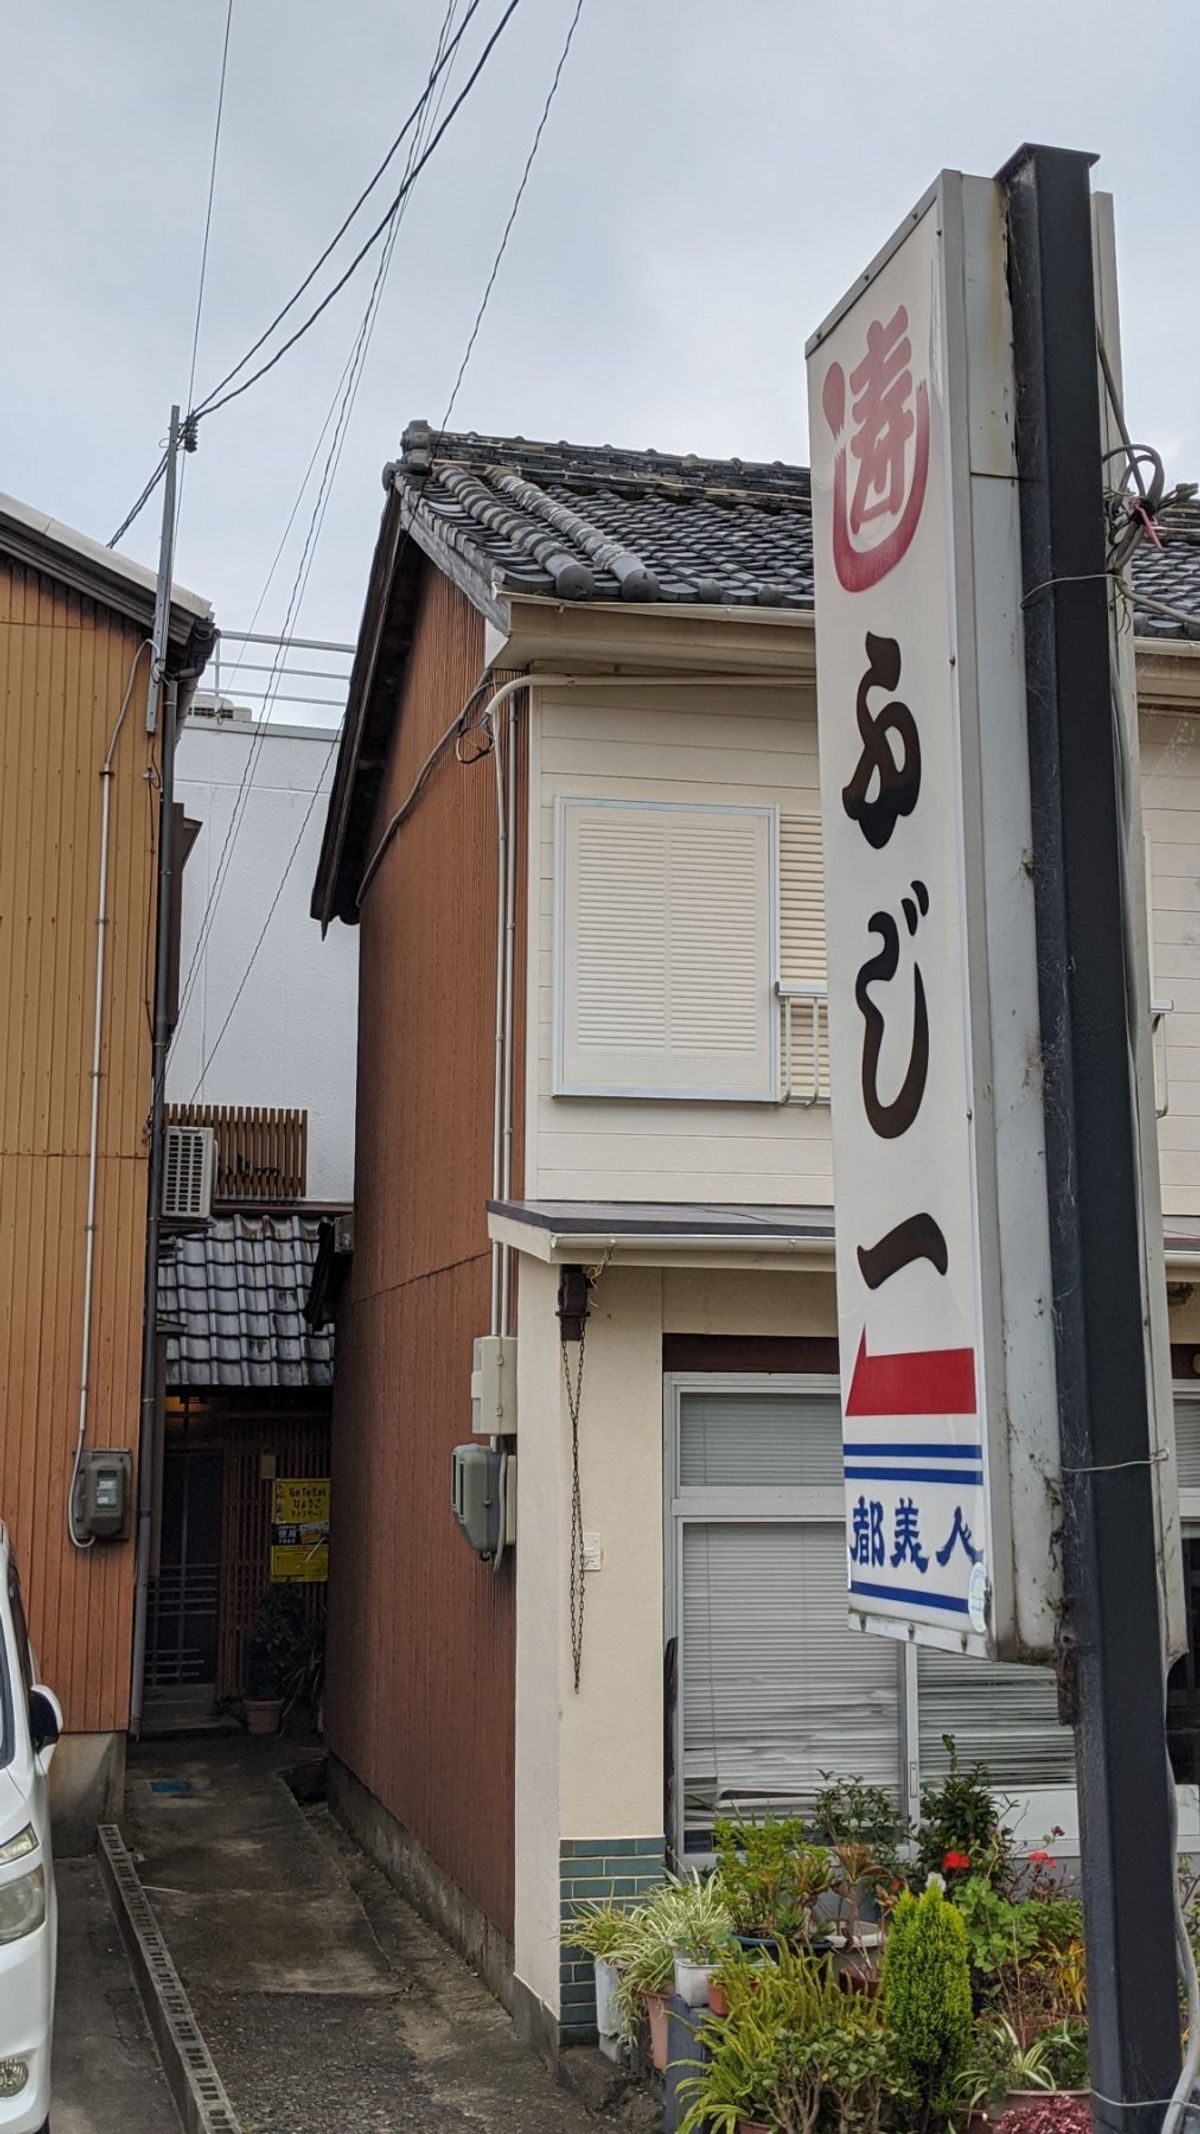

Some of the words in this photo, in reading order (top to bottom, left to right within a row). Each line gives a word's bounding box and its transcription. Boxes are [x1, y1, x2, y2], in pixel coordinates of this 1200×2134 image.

[289, 1487, 301, 1497] Go
[301, 1487, 312, 1497] To
[312, 1487, 326, 1497] Eat
[850, 1494, 984, 1574] 都美人
